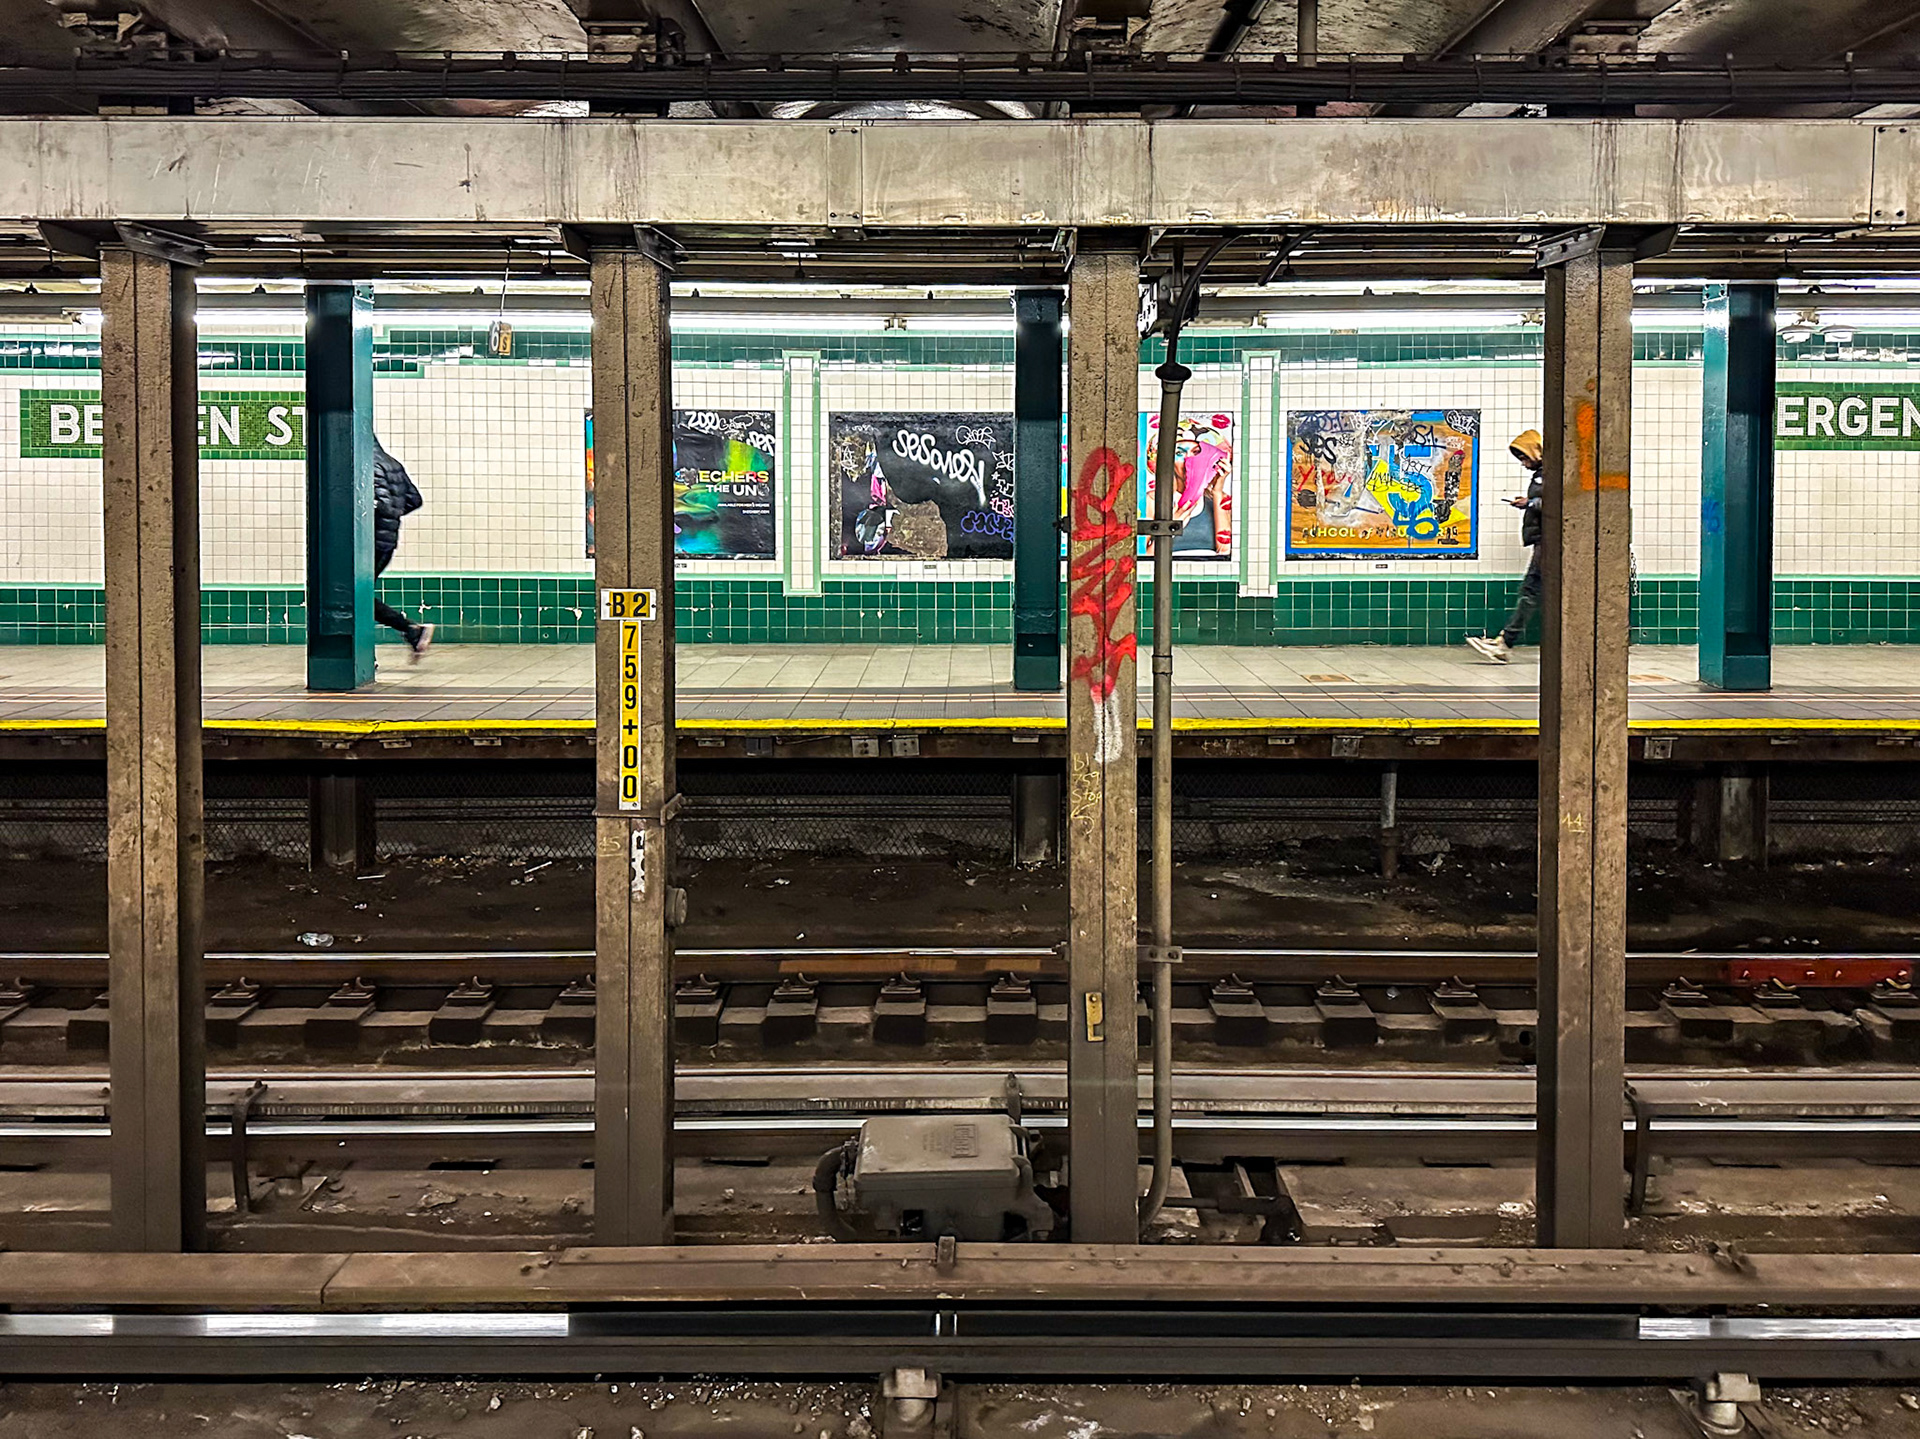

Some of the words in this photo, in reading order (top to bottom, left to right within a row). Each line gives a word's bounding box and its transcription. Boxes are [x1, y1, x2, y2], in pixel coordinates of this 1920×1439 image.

[50, 404, 240, 445] BEN
[1777, 397, 1920, 437] ERGEN
[706, 485, 729, 493] THE
